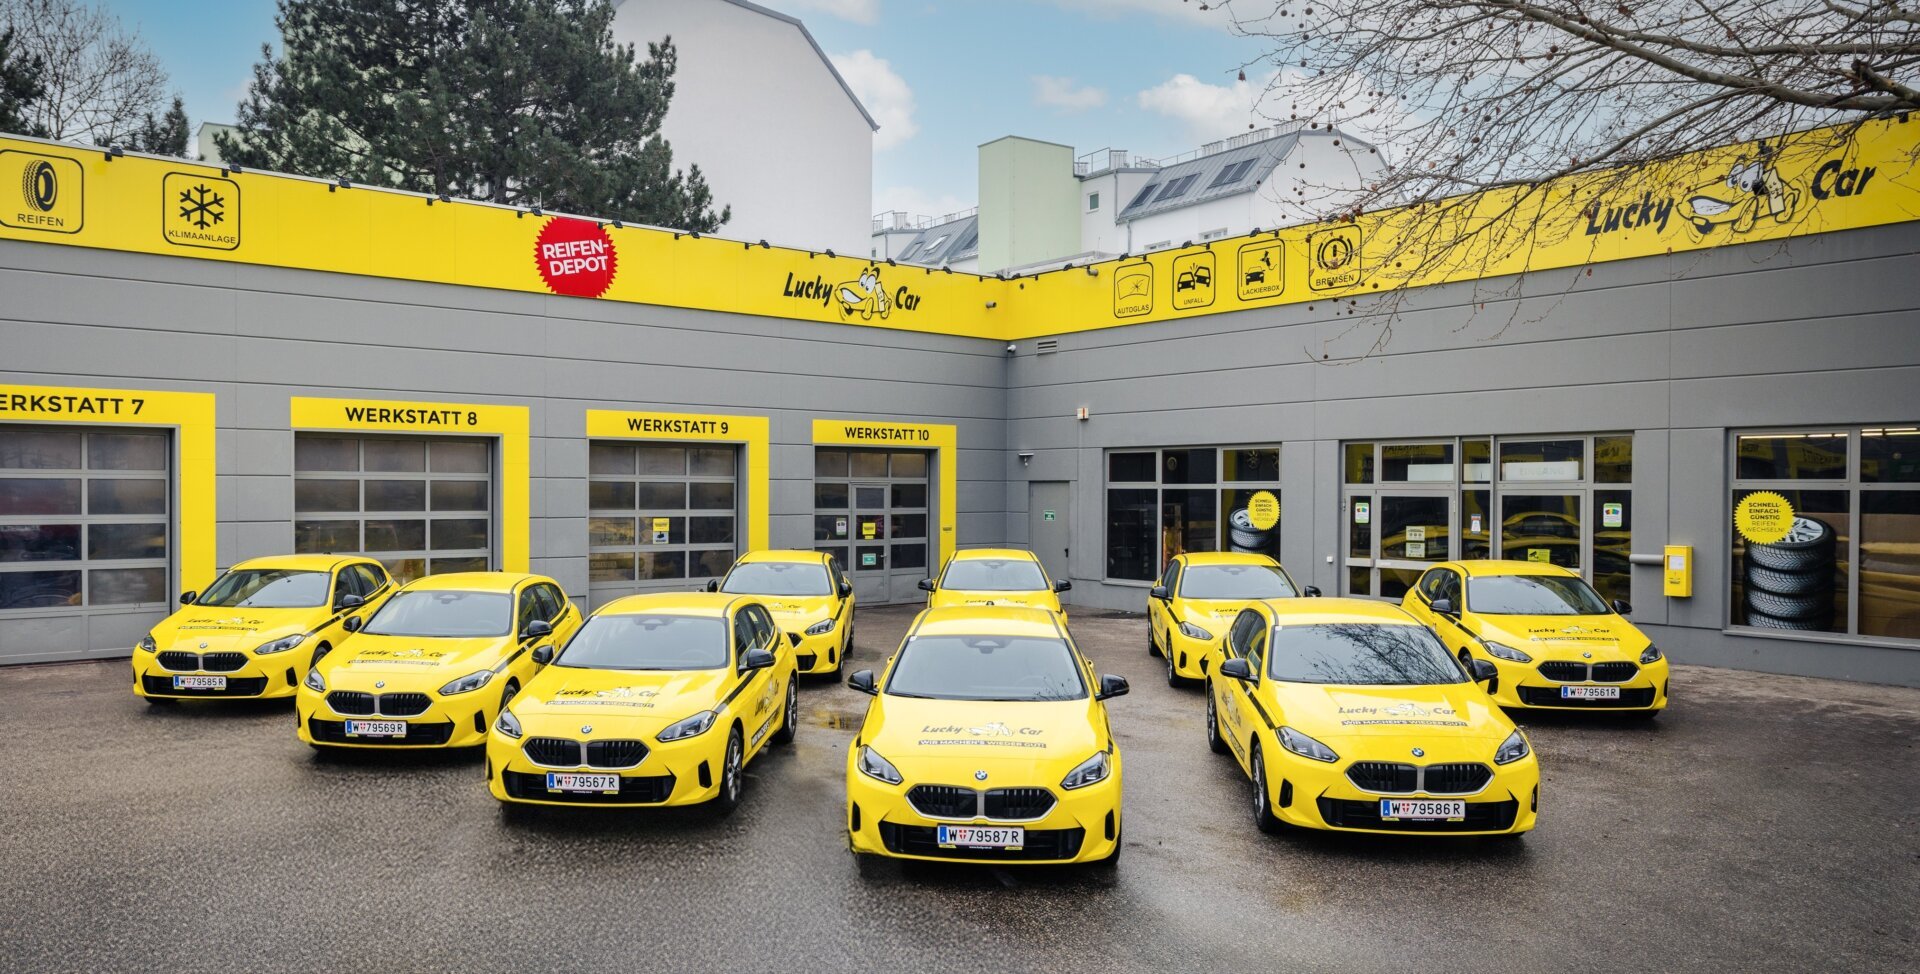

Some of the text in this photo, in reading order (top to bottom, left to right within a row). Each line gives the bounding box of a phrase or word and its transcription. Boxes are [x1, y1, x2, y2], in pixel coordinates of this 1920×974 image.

[1585, 160, 1877, 235] Lucky Car
[17, 213, 64, 227] REIFEN
[168, 229, 237, 244] KLIMAANLAGE
[542, 239, 609, 259] REIFEN-
[549, 256, 608, 276] DEPOT
[1315, 274, 1355, 287] BREMSEN
[783, 272, 921, 311] Lucky Car
[1242, 285, 1280, 296] LACKIERBOX
[1117, 304, 1150, 315] AUTOGLAS
[132, 399, 144, 415] 7
[345, 407, 477, 426] WERKSTATT 8
[627, 418, 729, 434] WERKSTATT 9
[845, 427, 929, 440] WERKSTATT 10
[180, 677, 186, 685] W
[556, 689, 660, 698] Lucky Car
[1569, 688, 1576, 696] W
[1338, 706, 1456, 715] Lucky Car
[353, 723, 360, 732] W
[921, 725, 1043, 736] Lucky Car
[555, 776, 564, 786] W
[572, 776, 606, 788] 79567
[1392, 803, 1401, 814] W
[1411, 803, 1450, 815] 79586
[1454, 803, 1460, 815] R
[948, 829, 957, 841] W
[968, 830, 1008, 843] 79587
[1012, 831, 1019, 843] R
